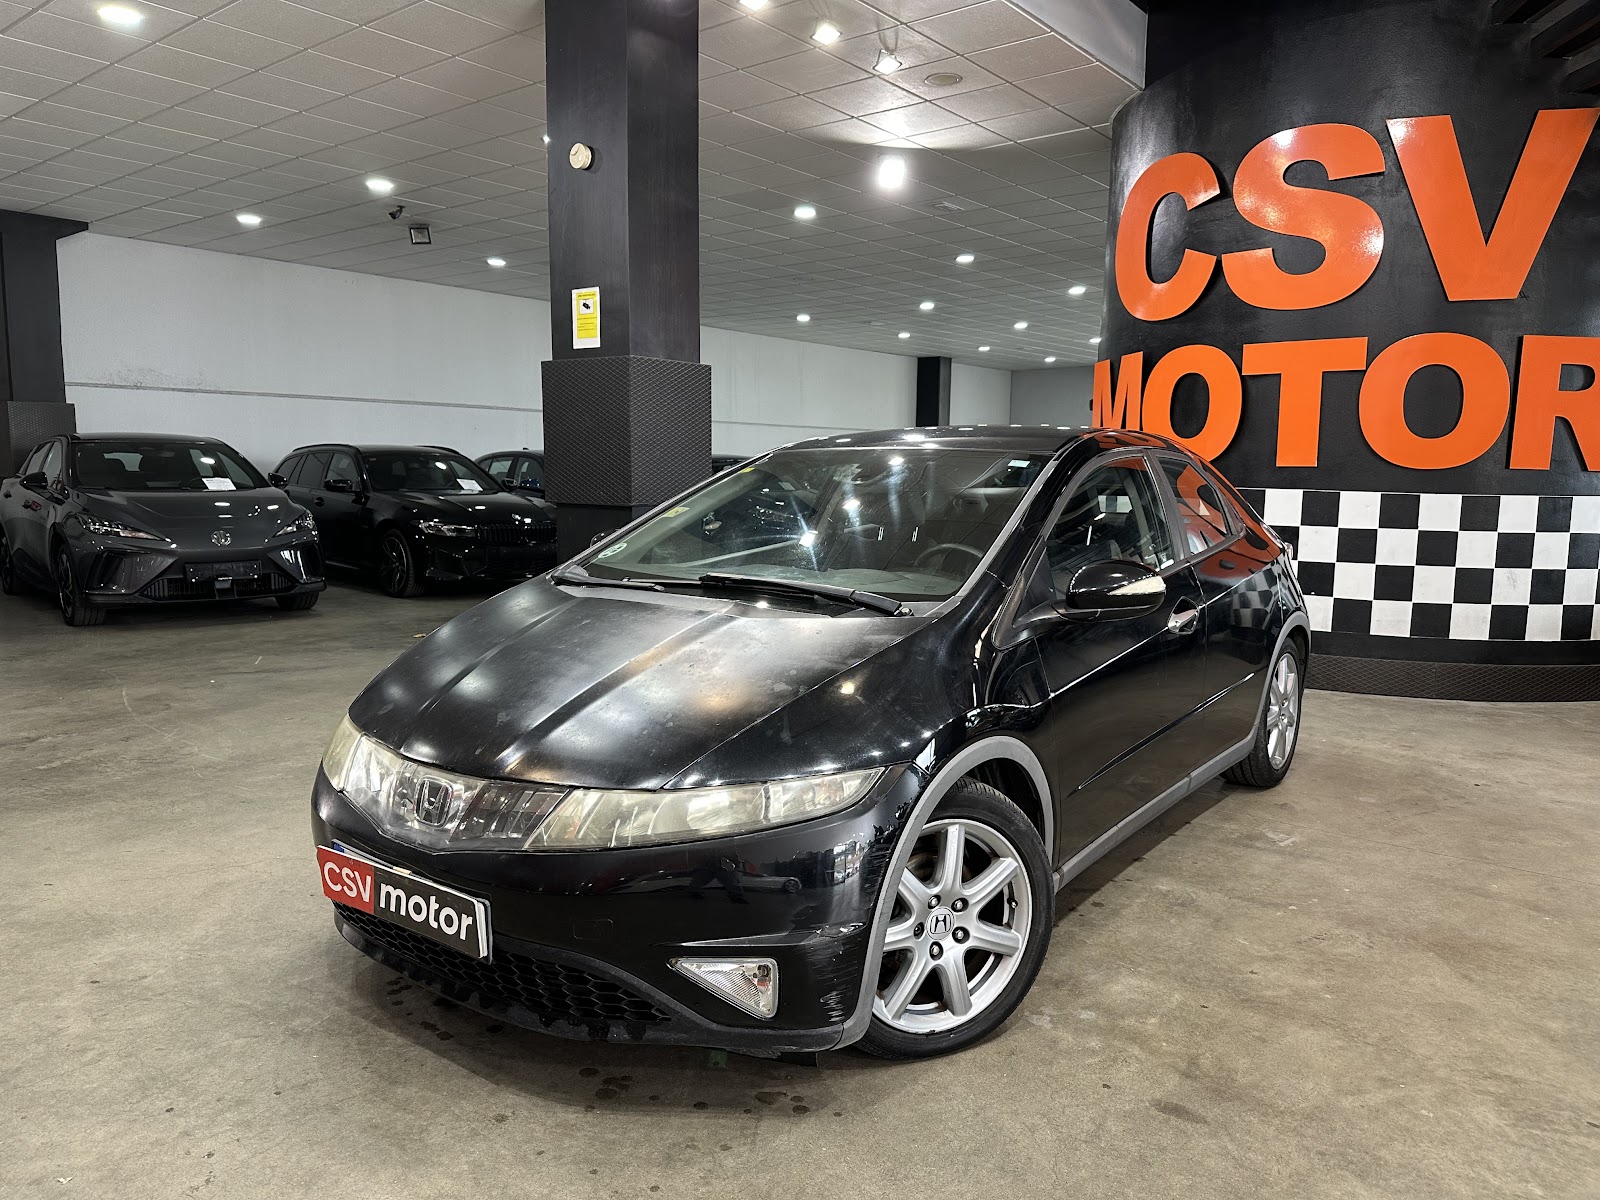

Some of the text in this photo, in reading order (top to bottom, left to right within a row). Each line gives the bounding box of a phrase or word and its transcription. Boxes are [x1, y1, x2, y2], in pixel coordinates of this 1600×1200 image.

[1115, 108, 1600, 322] CSV
[1092, 332, 1600, 472] MOTOR
[323, 861, 473, 941] CSV motor
